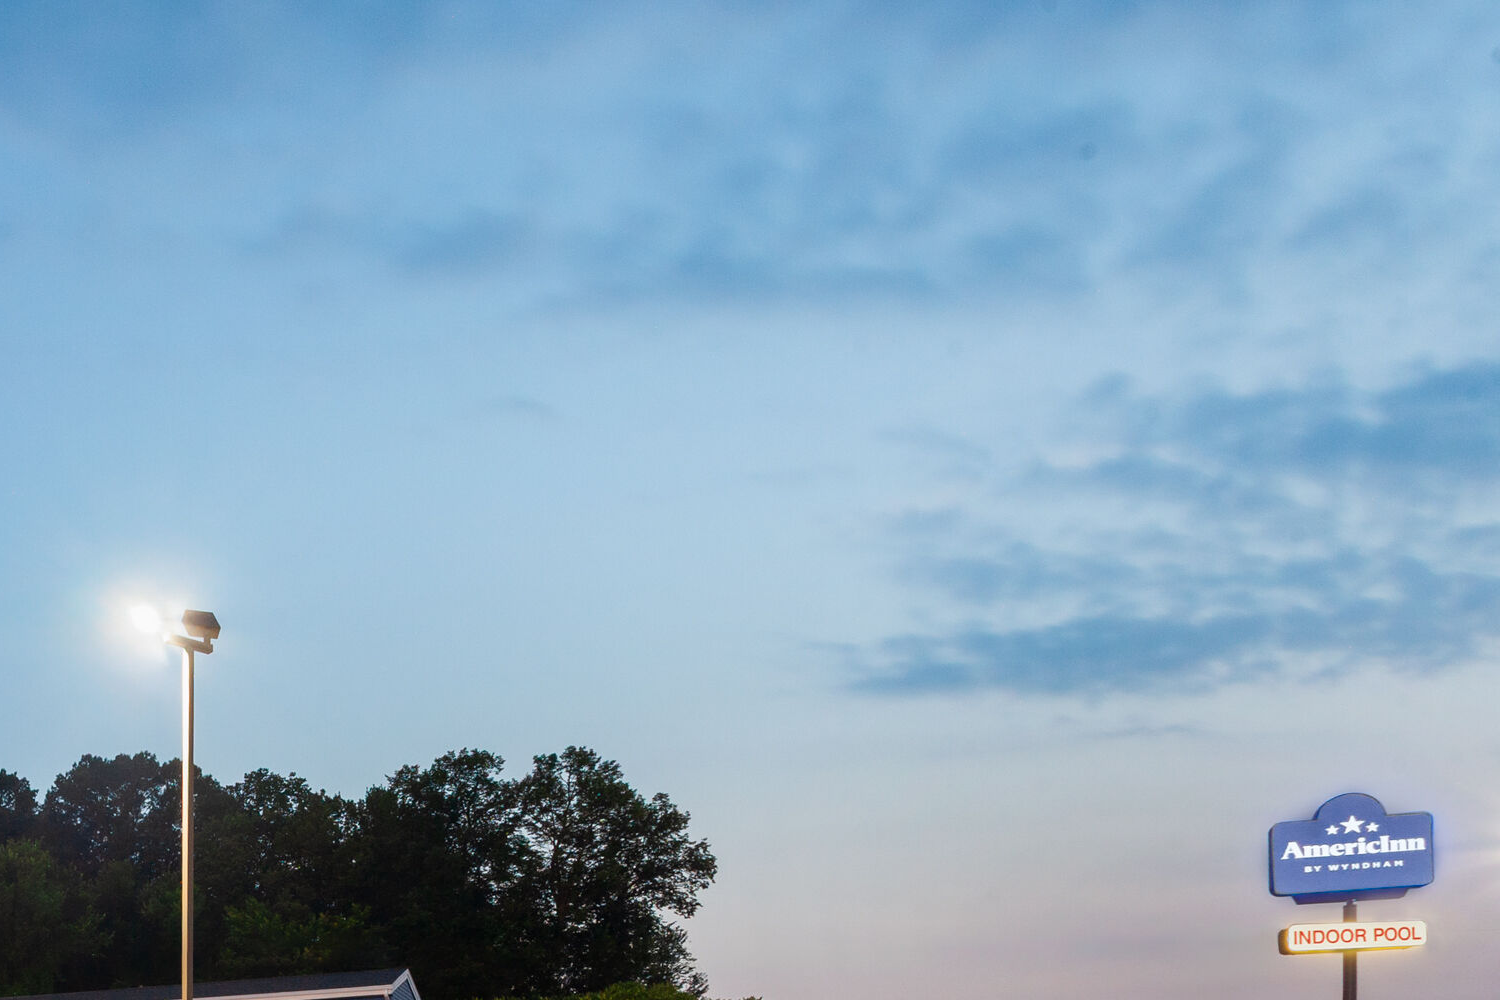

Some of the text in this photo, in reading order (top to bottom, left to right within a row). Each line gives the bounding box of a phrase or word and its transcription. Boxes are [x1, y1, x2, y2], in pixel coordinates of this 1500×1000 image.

[1304, 860, 1404, 873] BY WYNDHAM
[1293, 926, 1422, 945] INDOOR POOL
